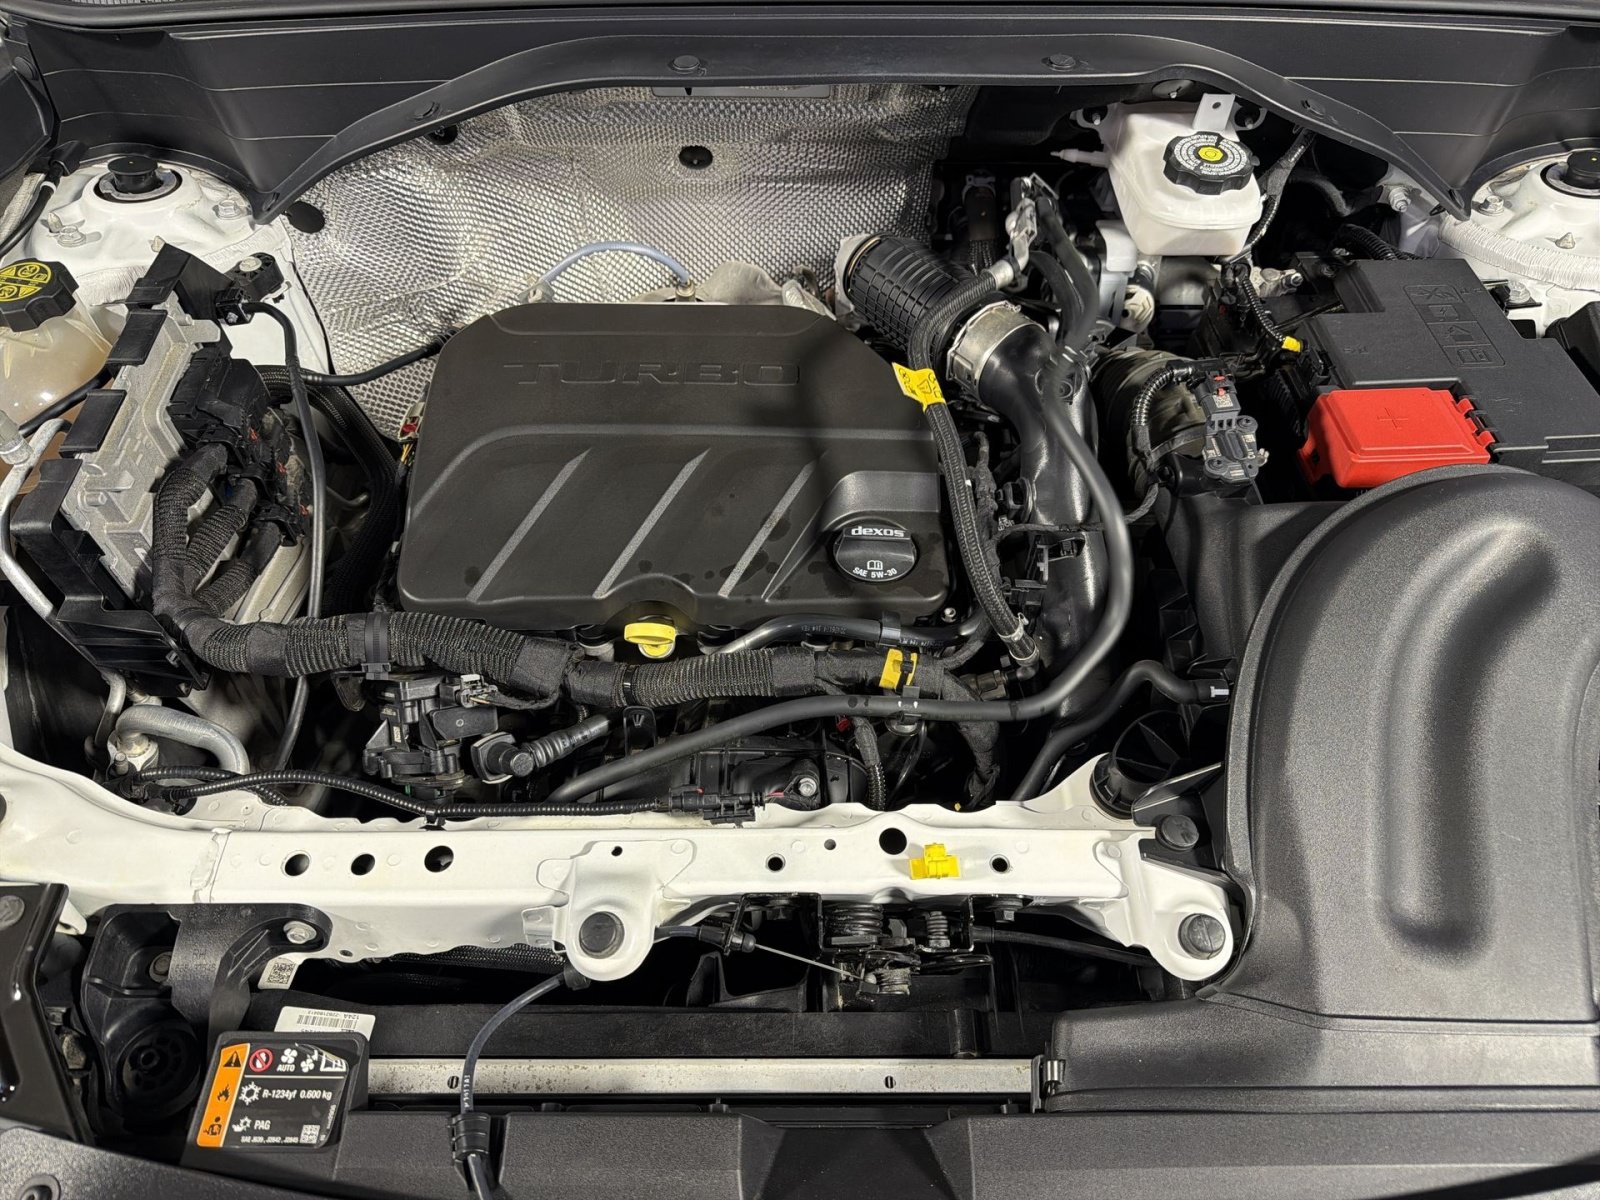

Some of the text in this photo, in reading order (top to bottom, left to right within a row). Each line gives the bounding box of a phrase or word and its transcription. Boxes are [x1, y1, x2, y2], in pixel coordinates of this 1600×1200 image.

[503, 360, 799, 386] TURBO
[851, 526, 905, 537] dexos
[852, 567, 898, 578] SAE 5W-30
[276, 1064, 295, 1072] AUTO
[262, 1089, 333, 1101] R-1234yf 0.600 kg
[254, 1119, 271, 1131] PAG
